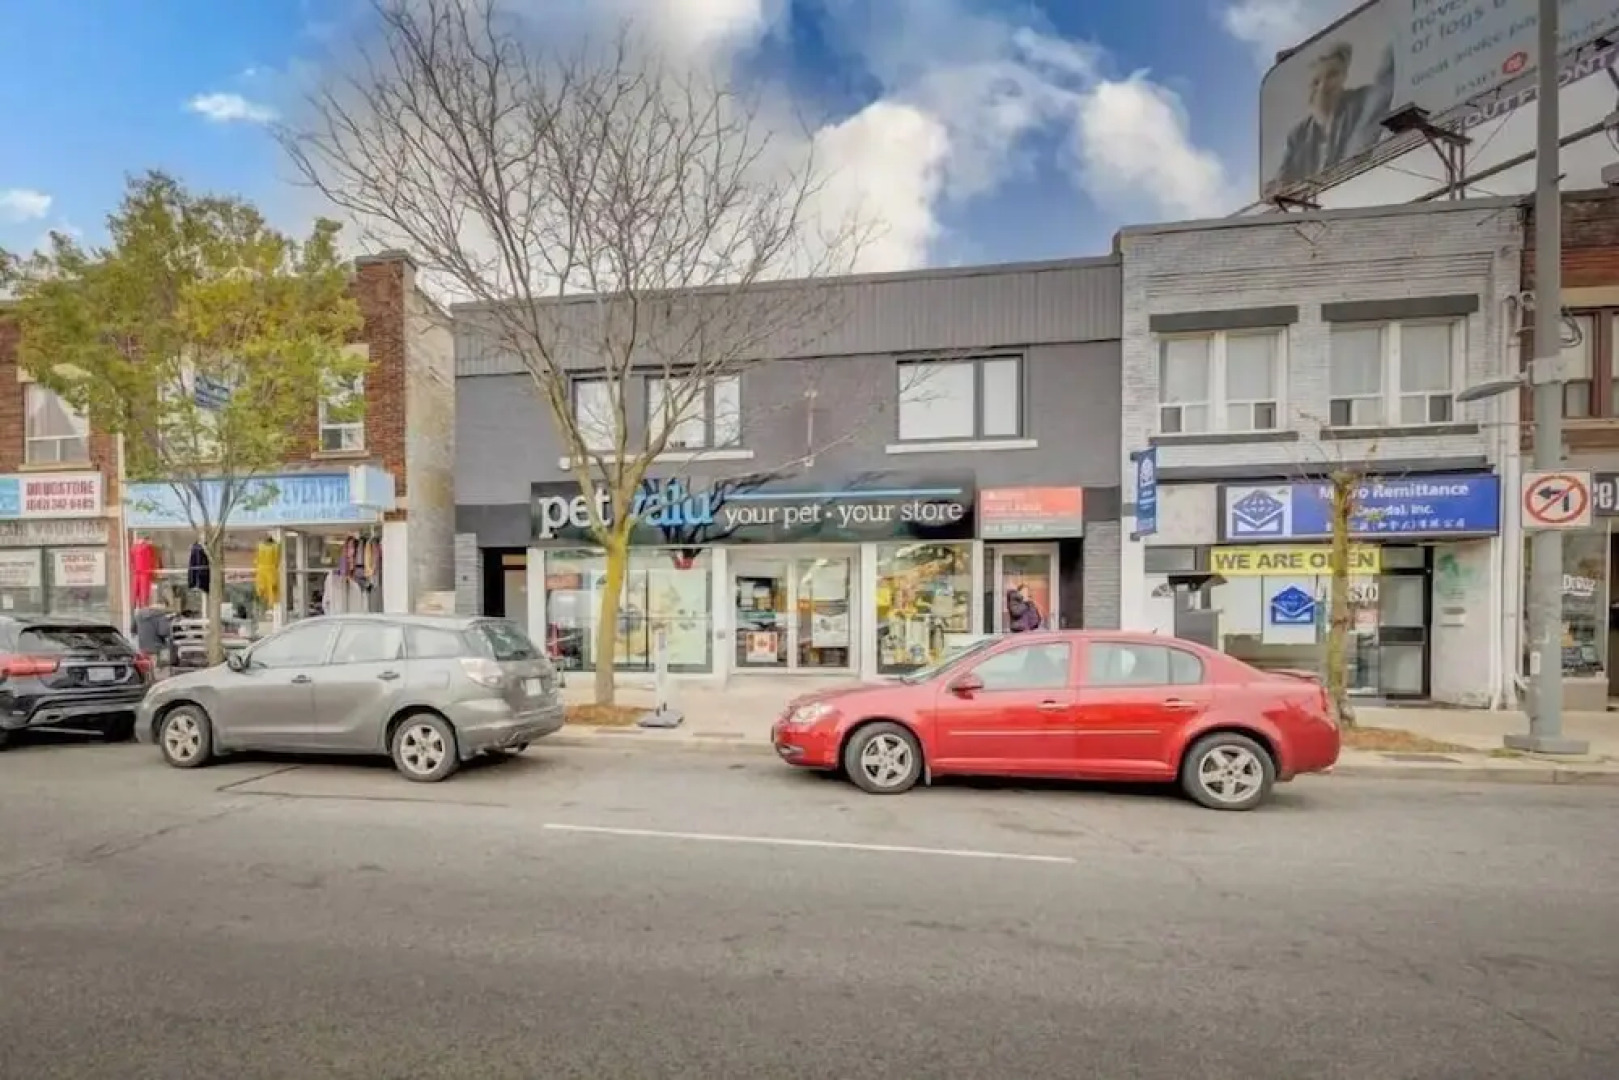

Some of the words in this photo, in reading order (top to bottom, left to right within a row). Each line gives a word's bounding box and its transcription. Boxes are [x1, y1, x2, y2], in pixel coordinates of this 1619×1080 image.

[1373, 482, 1469, 498] Remittance
[539, 487, 614, 539] pet
[725, 506, 778, 531] your
[783, 503, 821, 529] pet
[837, 502, 895, 528] your
[900, 499, 963, 521] store
[1215, 554, 1249, 569] WE
[1257, 553, 1303, 569] ARE
[1309, 551, 1374, 568] OEN
